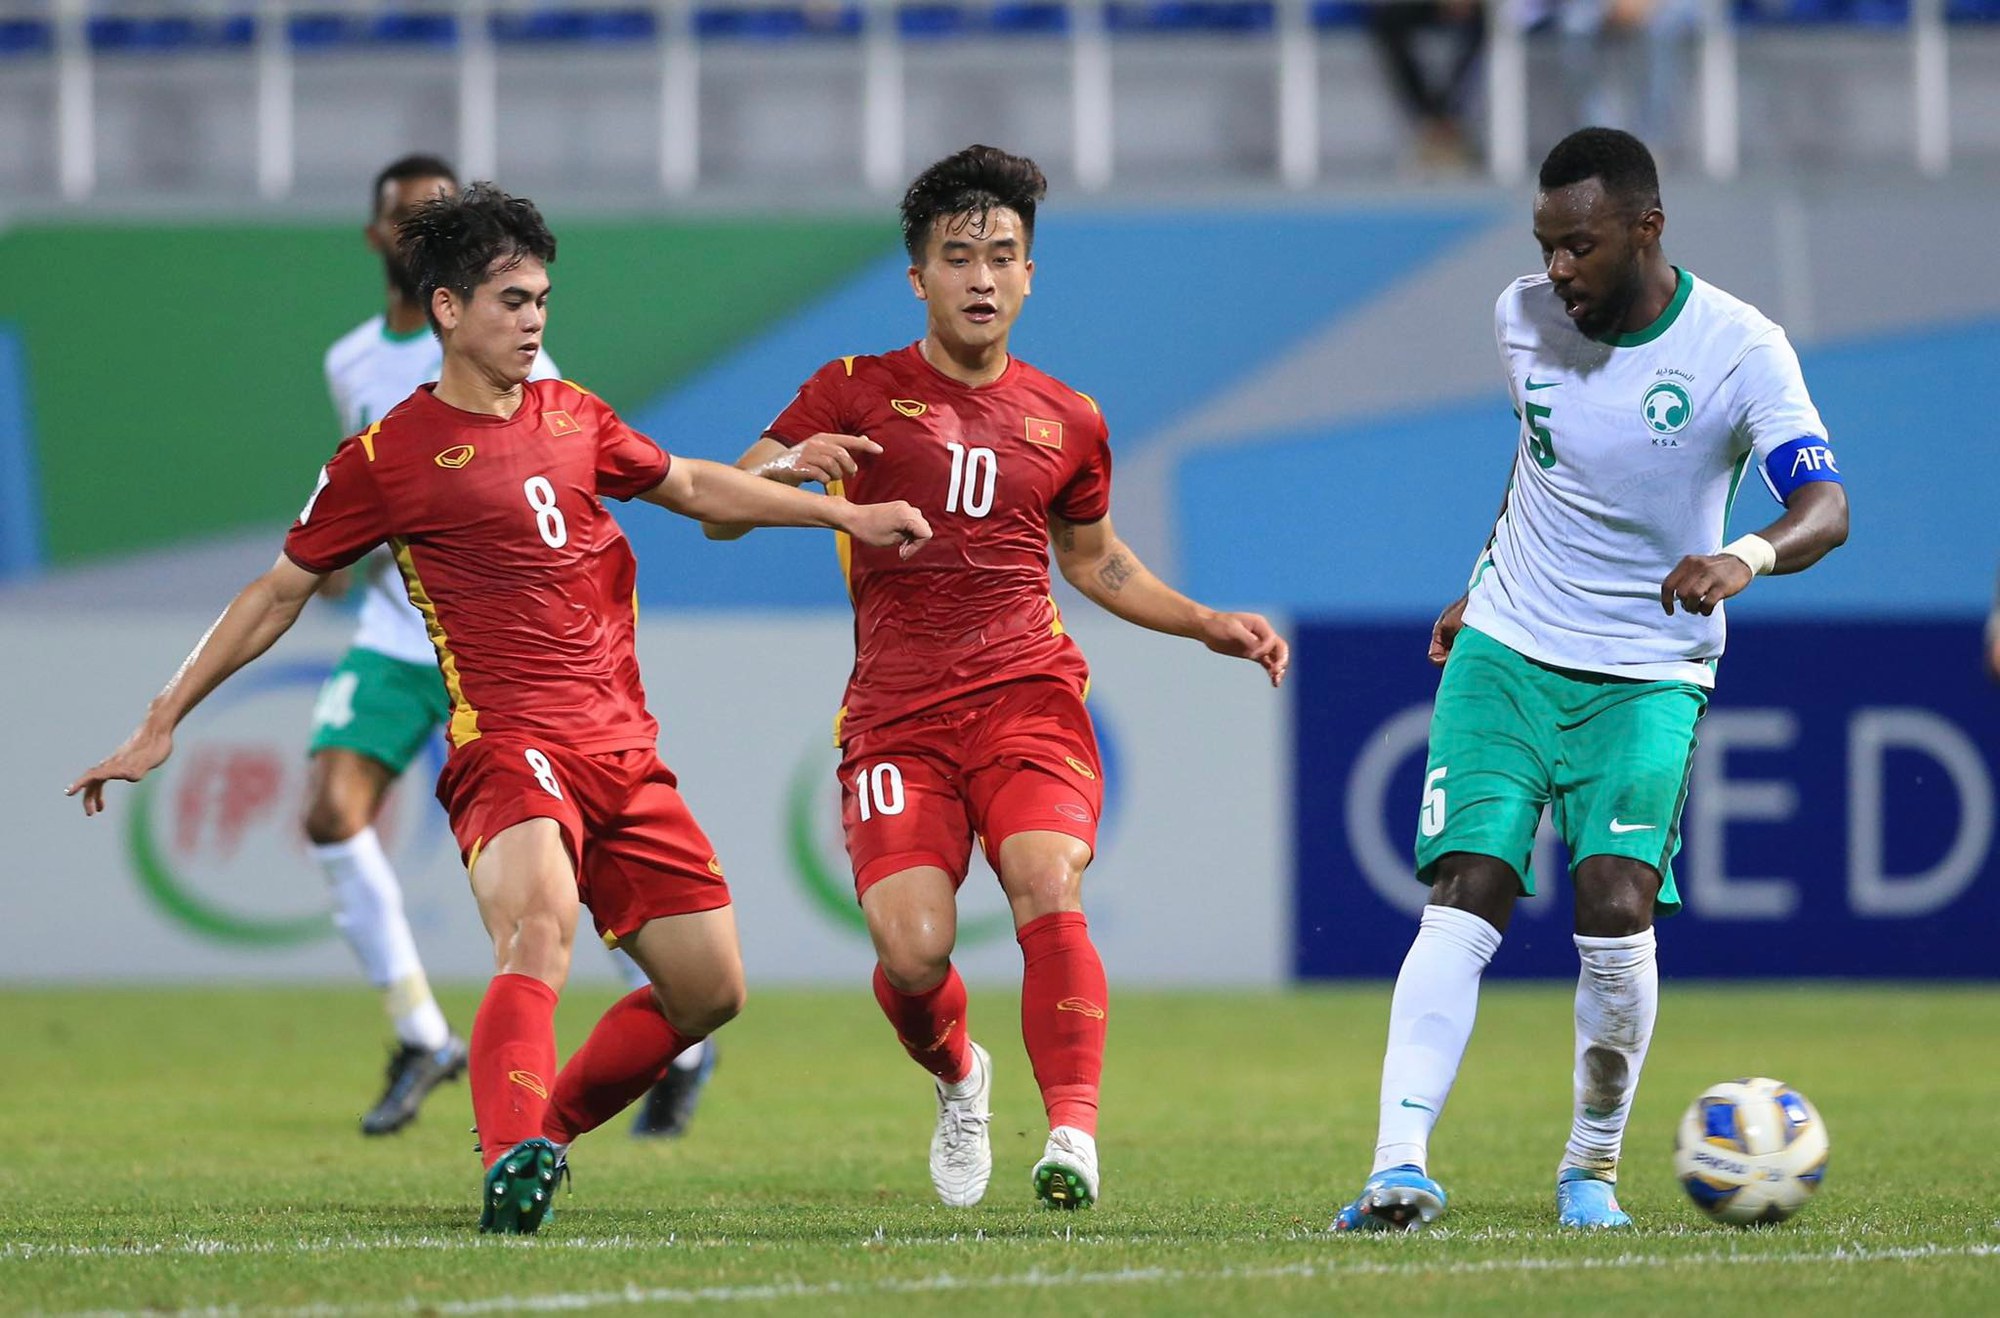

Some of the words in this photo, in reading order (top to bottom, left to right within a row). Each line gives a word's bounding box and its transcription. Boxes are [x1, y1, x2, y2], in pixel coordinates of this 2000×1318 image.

[1656, 367, 1696, 383] السعودية
[1525, 401, 1557, 469] 5
[1790, 445, 1840, 478] AFC
[945, 441, 998, 518] 10
[523, 475, 568, 549] 8
[524, 748, 564, 800] 8
[856, 762, 905, 822] 10
[1421, 766, 1448, 837] 5
